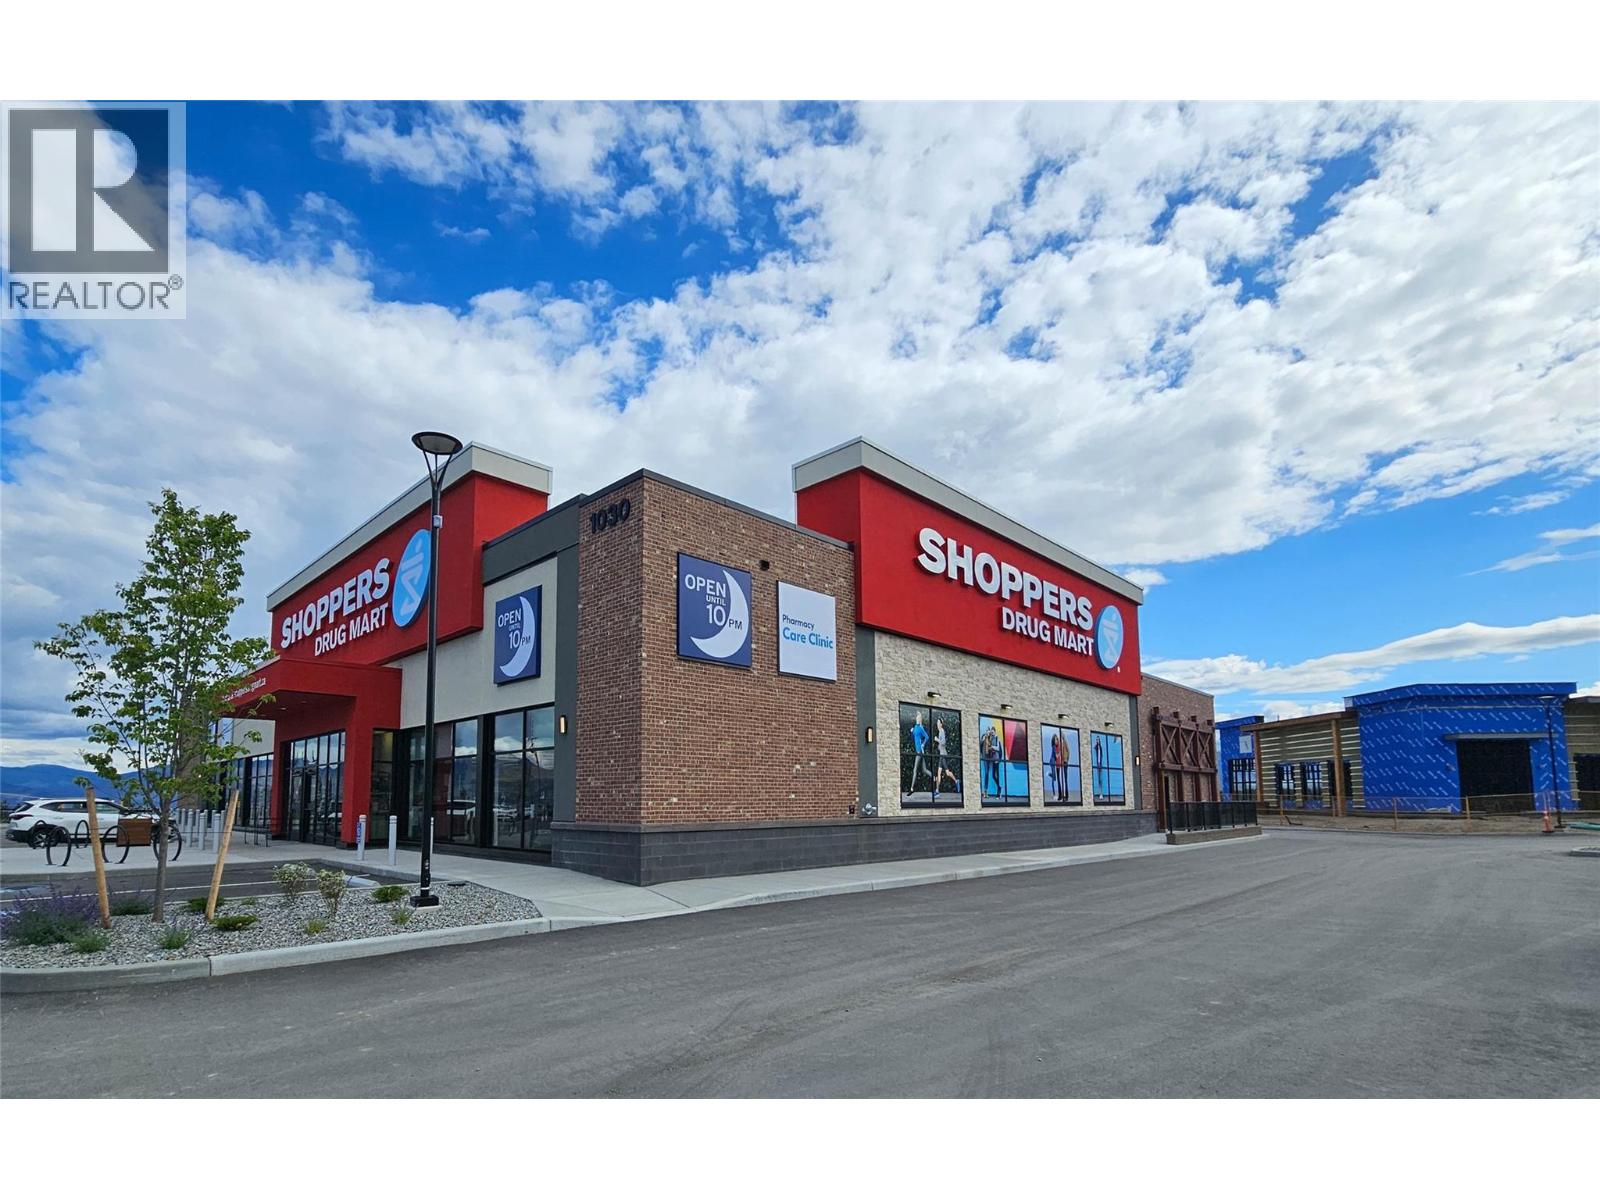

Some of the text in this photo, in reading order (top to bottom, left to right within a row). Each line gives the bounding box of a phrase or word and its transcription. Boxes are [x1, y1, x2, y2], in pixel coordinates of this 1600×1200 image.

[591, 498, 631, 534] 1030
[685, 573, 726, 598] OPEN
[917, 527, 1094, 631] SHOPPERS
[280, 557, 390, 649] SHOPPERS
[706, 594, 726, 606] UNTIL
[314, 602, 389, 657] DRUG MART
[497, 607, 522, 628] OPEN
[706, 604, 743, 631] 10 PM
[782, 614, 815, 631] Pharmacy
[508, 629, 531, 649] 10 PM
[782, 627, 834, 649] Care Clinic
[1002, 606, 1094, 657] DRUG MART
